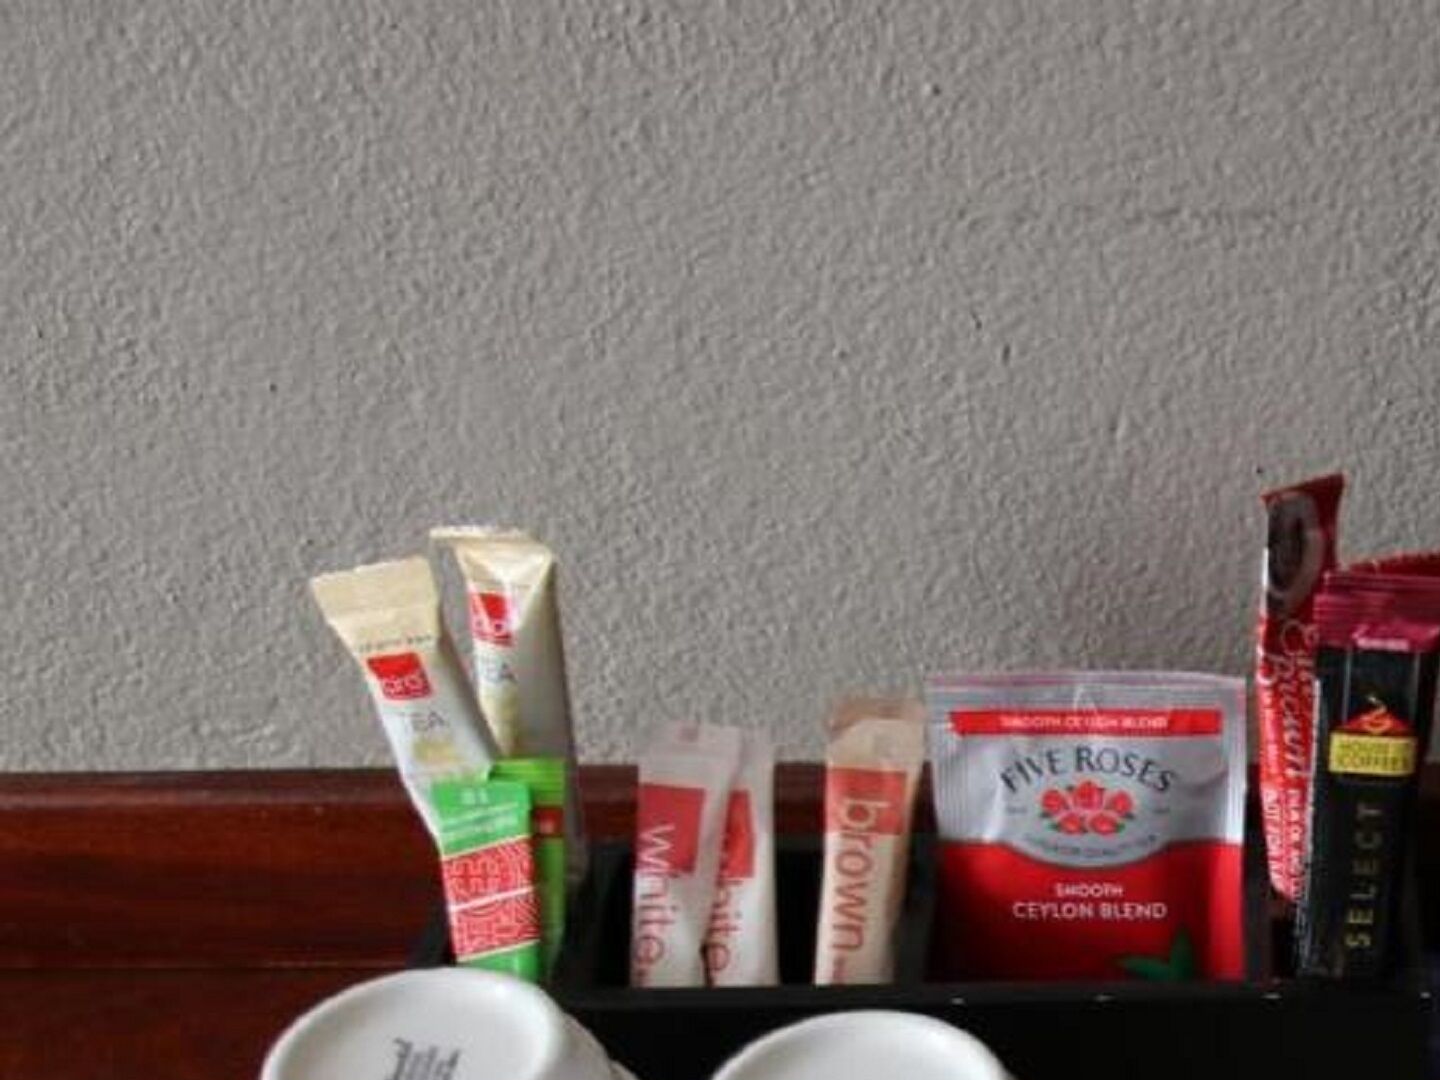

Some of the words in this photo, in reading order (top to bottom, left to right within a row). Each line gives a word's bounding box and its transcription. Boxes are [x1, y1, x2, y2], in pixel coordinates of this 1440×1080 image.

[1000, 747, 1062, 794] FIVE
[1075, 744, 1179, 792] ROSES
[635, 822, 678, 965] white
[833, 797, 891, 952] brown
[1012, 902, 1094, 919] CEYLON
[1100, 902, 1167, 920] BLEND
[1056, 882, 1123, 898] SMOOTH
[1345, 804, 1383, 948] SELECT
